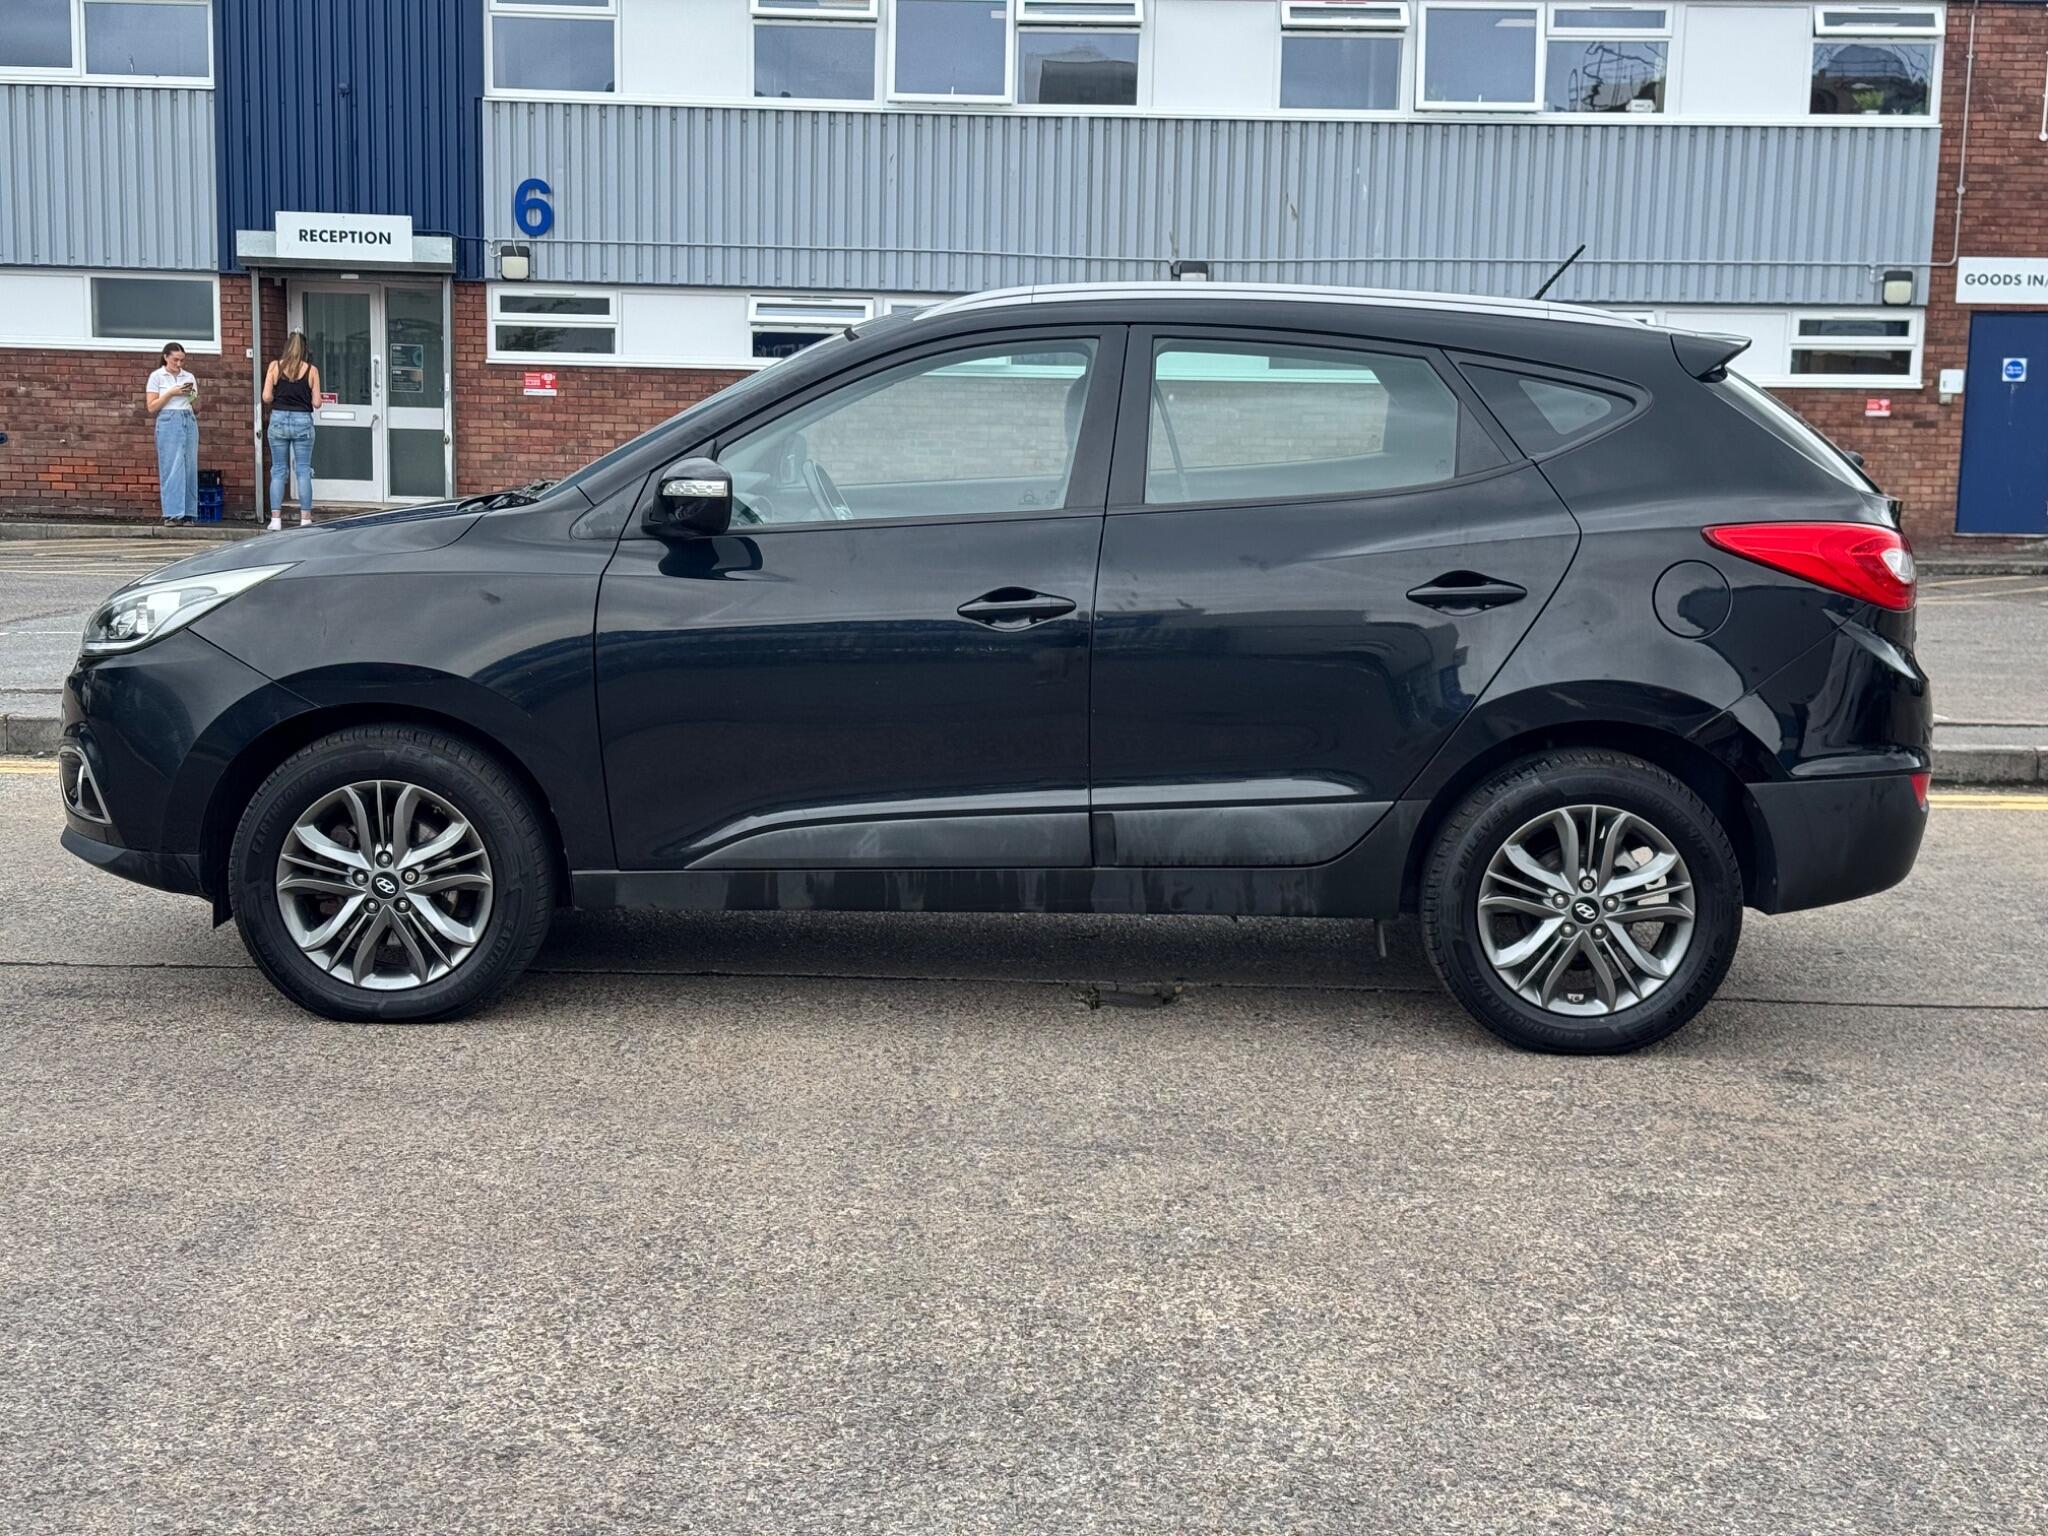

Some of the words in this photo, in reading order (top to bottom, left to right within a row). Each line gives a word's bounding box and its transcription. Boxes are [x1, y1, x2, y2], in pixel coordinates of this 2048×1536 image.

[514, 178, 554, 236] 6
[298, 228, 391, 245] RECEPTION
[1965, 273, 2022, 286] GOODS
[1455, 800, 1511, 870] MILEVER
[1664, 953, 1719, 1023] MILEVER
